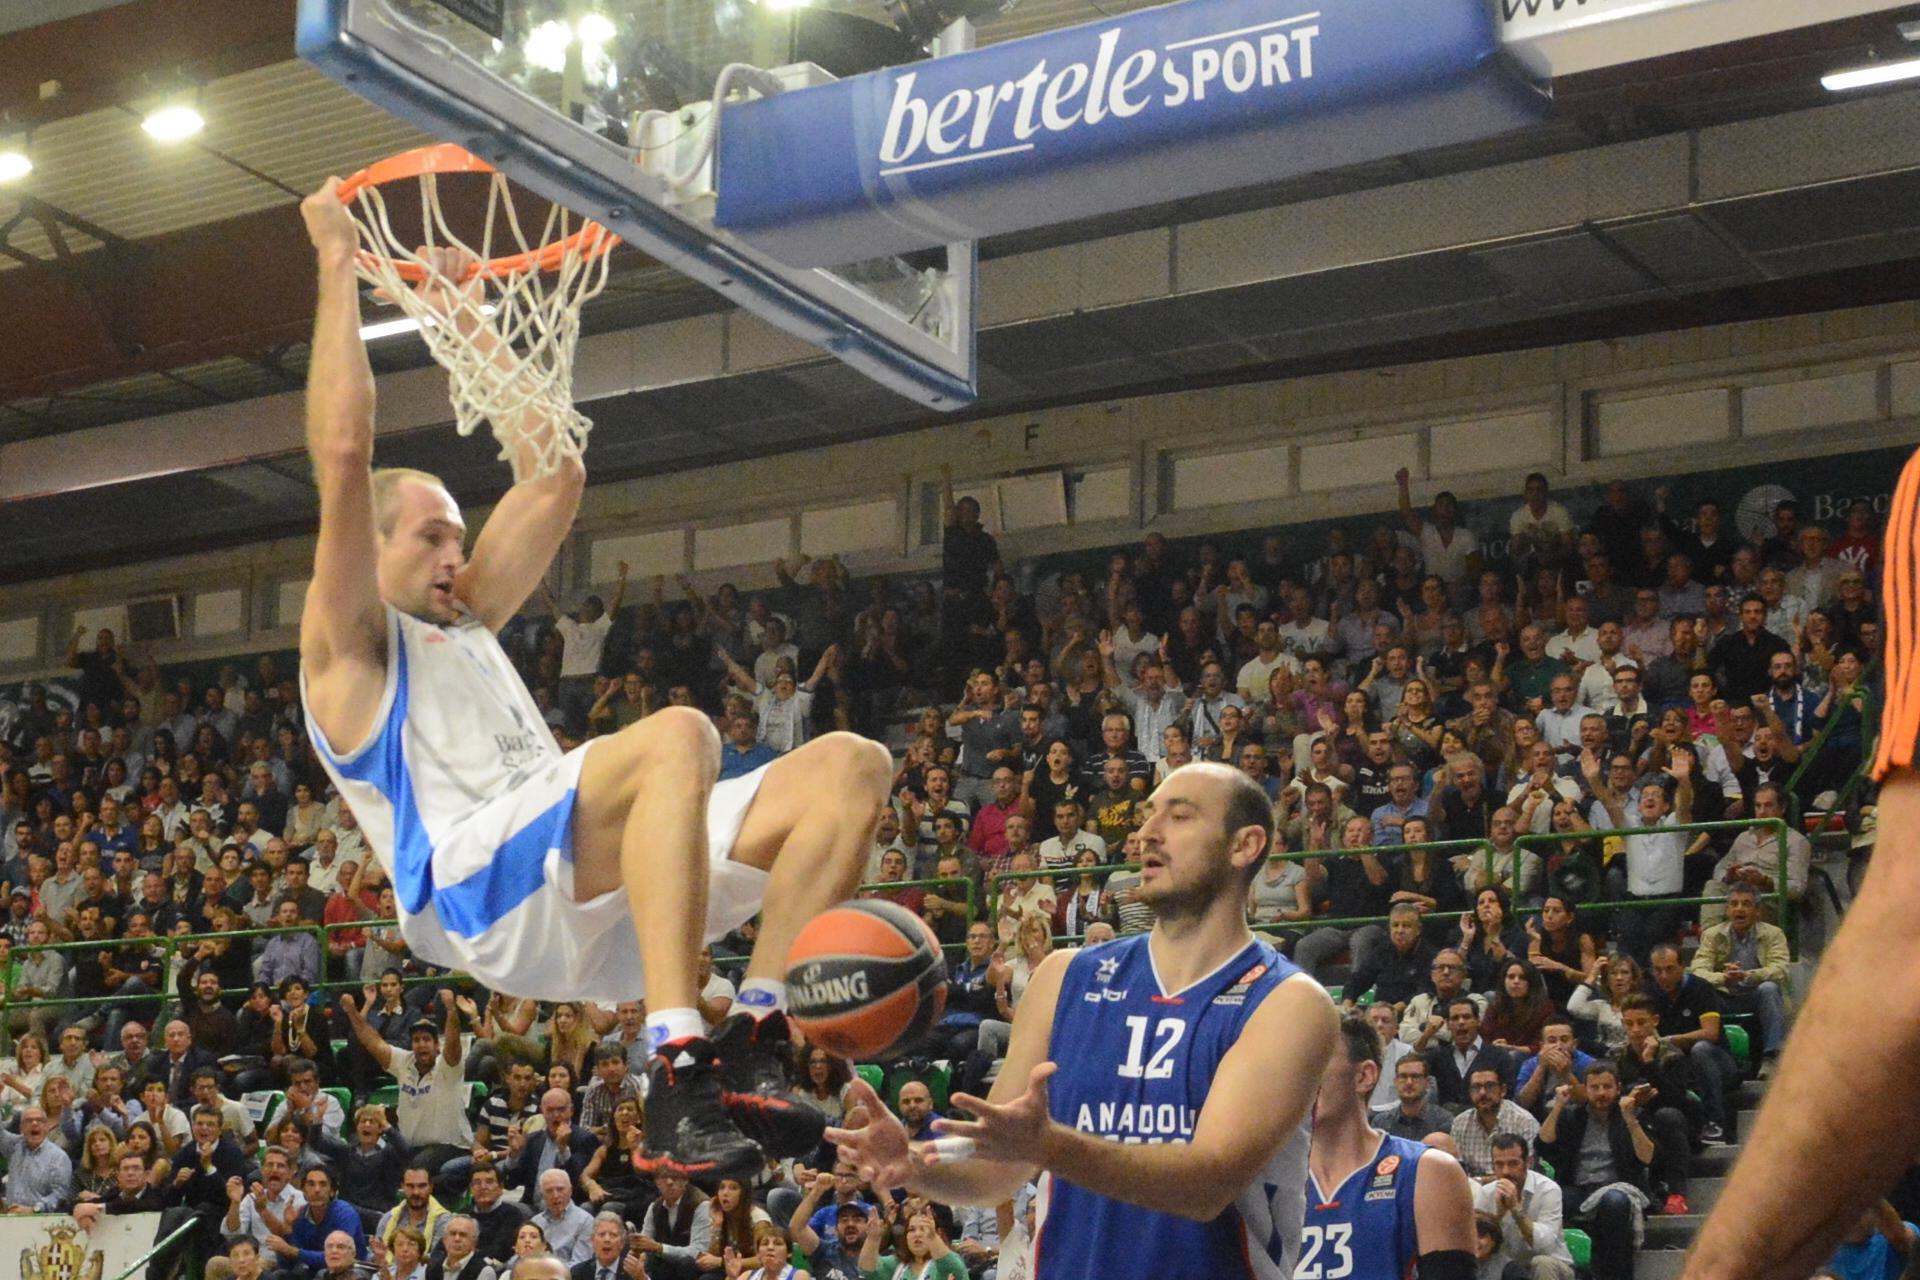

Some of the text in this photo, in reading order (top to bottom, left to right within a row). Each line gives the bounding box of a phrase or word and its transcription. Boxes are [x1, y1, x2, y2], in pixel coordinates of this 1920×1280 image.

[879, 25, 1320, 164] bertele SPORT
[1117, 1015, 1186, 1080] 12
[1076, 1102, 1196, 1135] ANADOL
[1293, 1222, 1353, 1280] 23
